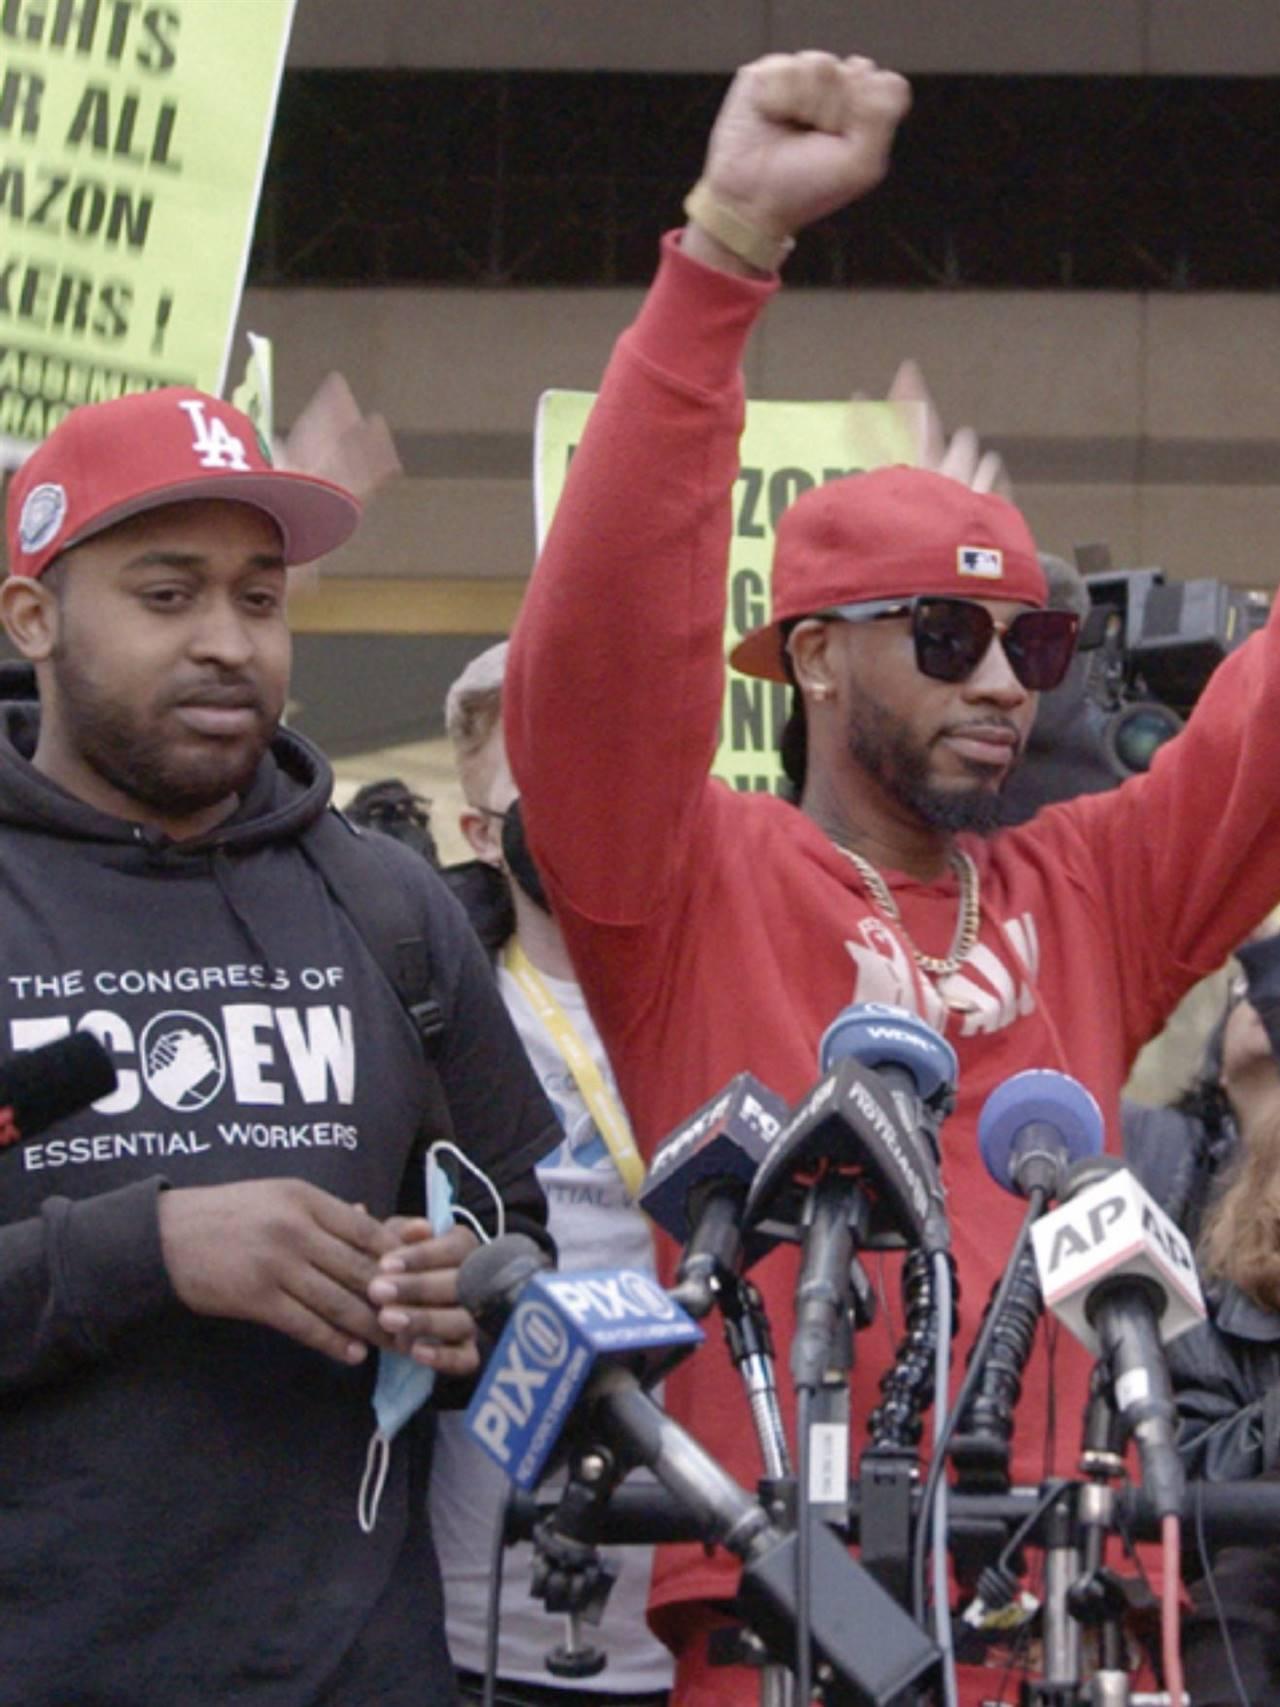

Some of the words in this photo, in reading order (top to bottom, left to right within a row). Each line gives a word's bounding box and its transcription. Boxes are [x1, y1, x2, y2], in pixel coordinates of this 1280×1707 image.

[65, 84, 182, 172] ALL
[178, 400, 250, 472] LA
[9, 970, 85, 999] THE
[94, 964, 291, 995] CONGRESS
[300, 966, 345, 991] OF
[24, 1131, 211, 1171] ESSENTIAL
[217, 1122, 358, 1152] WORKERS
[1048, 1195, 1128, 1274] AP
